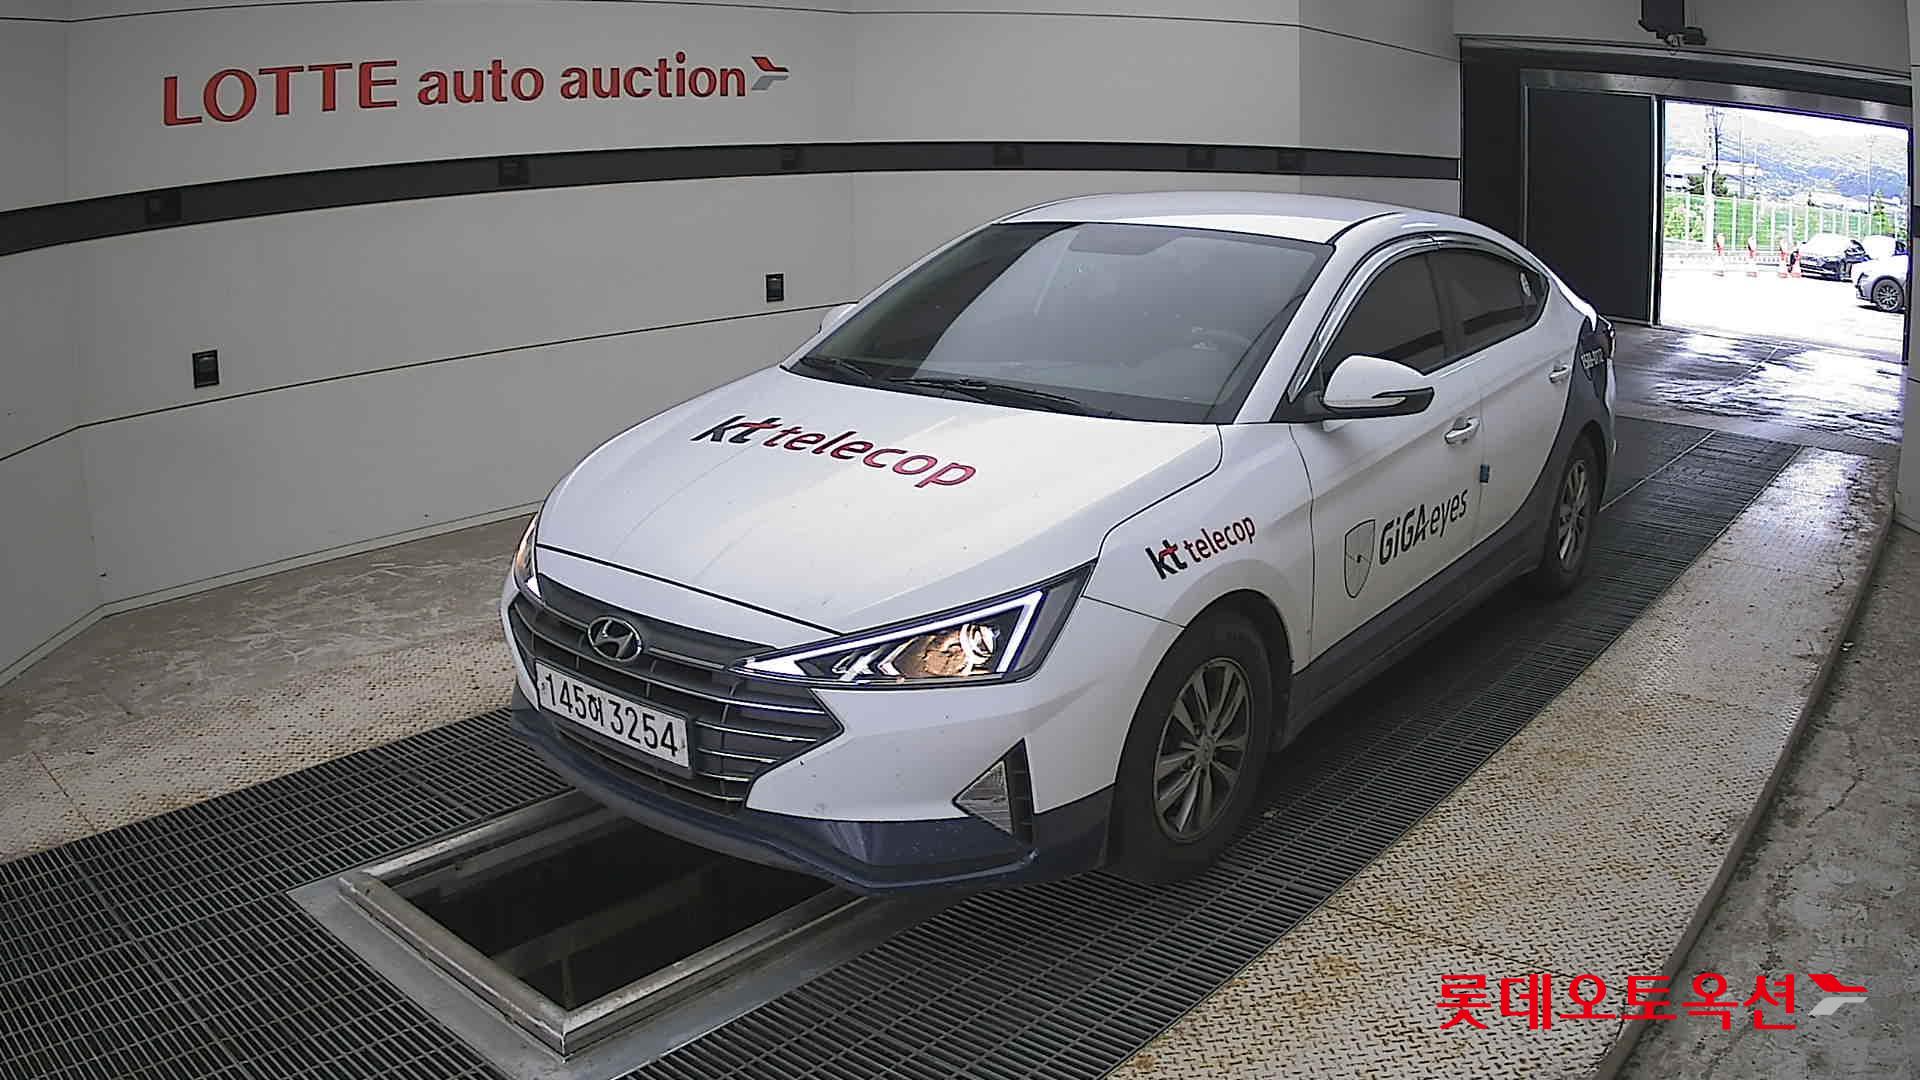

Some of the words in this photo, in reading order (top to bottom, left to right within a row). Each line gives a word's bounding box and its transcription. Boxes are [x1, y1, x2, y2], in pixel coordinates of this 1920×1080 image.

[163, 60, 398, 127] LOTTE
[417, 59, 545, 106] auto
[559, 51, 747, 99] auction
[690, 415, 783, 444] kt
[763, 426, 977, 488] telecop
[1145, 539, 1188, 580] kt
[1184, 516, 1257, 564] telecop
